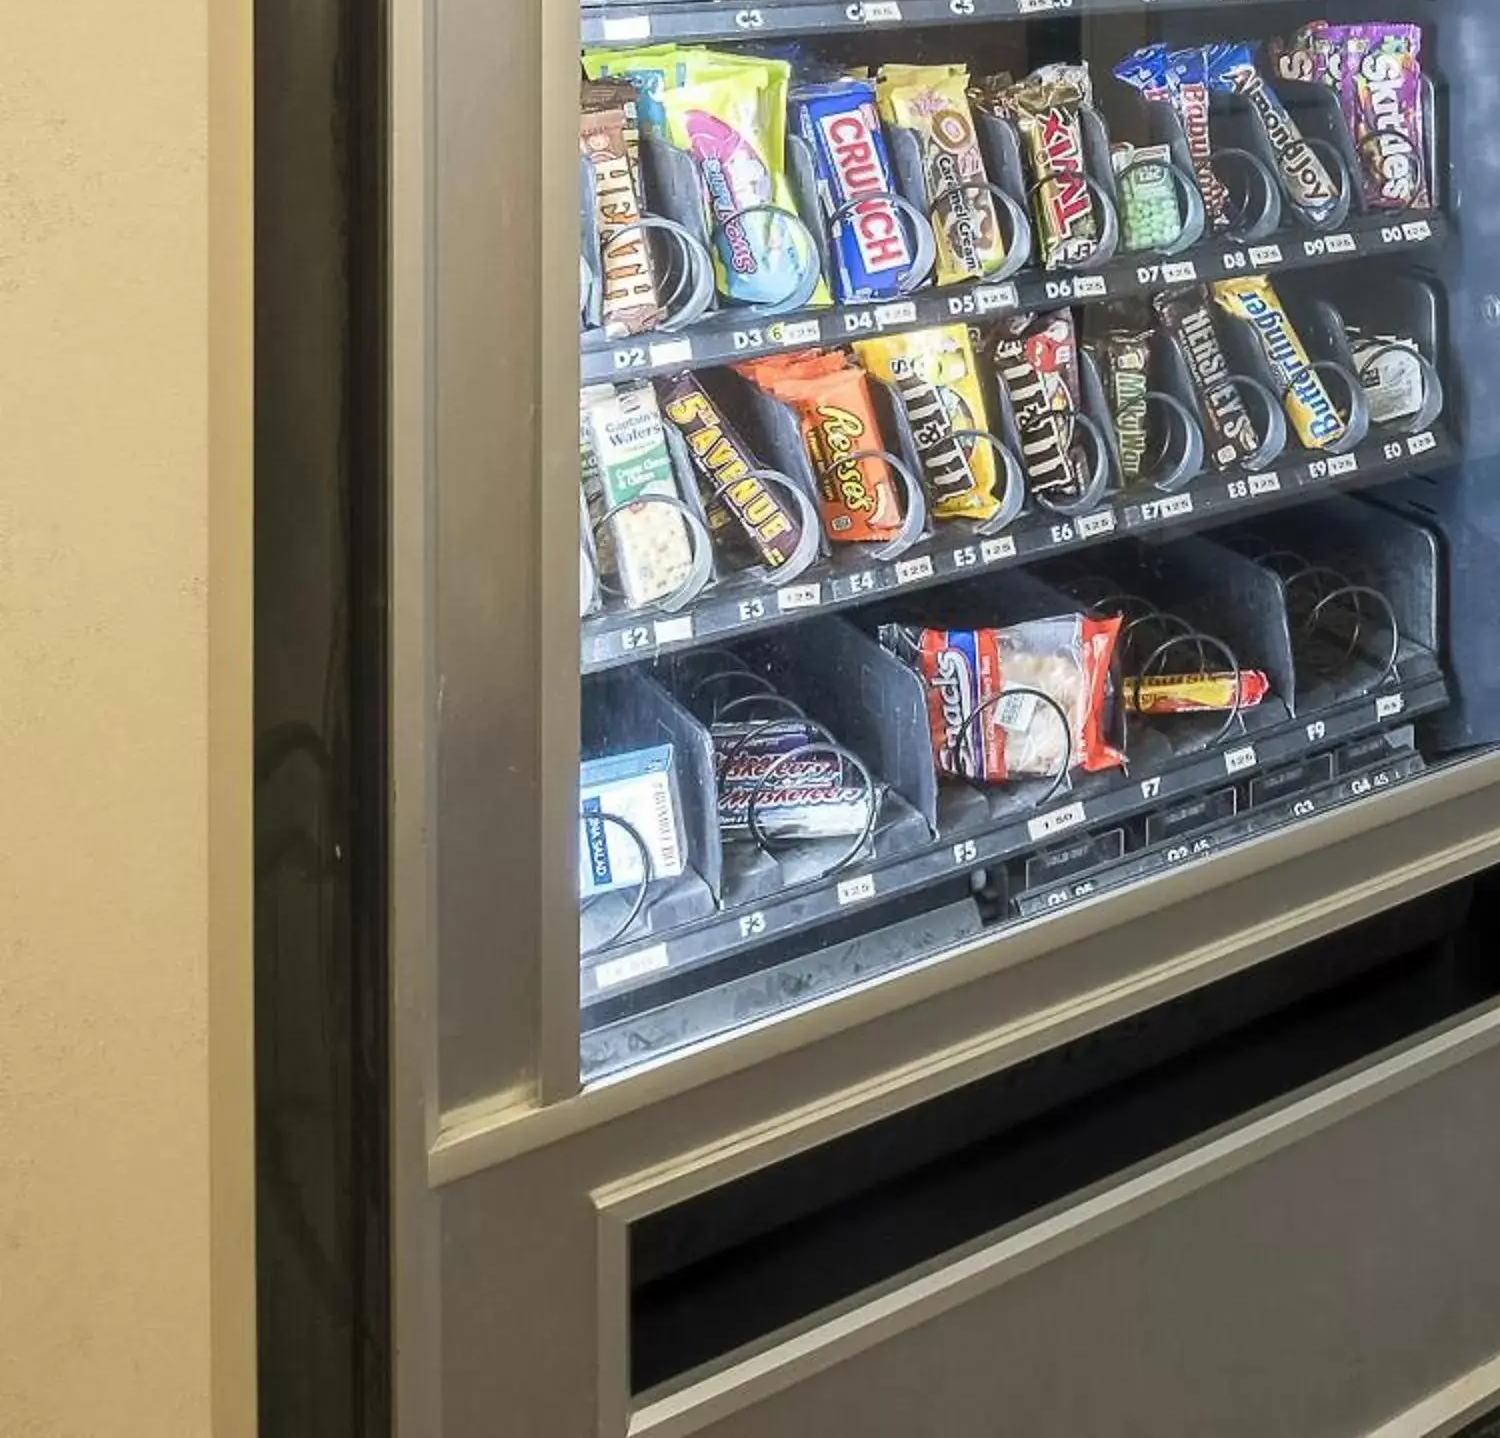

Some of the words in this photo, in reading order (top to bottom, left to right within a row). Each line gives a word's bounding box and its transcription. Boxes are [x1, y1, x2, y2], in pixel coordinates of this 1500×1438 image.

[735, 9, 764, 28] C3
[1361, 52, 1412, 201] Skitles
[1038, 106, 1094, 241] TWIX
[828, 116, 904, 266] CRUNCH
[938, 155, 968, 221] Carmel
[1381, 227, 1402, 244] D0
[1303, 240, 1325, 257] D9
[1223, 252, 1246, 270] D8
[1136, 267, 1160, 285] D7
[1045, 280, 1072, 297] D6
[949, 296, 976, 315] D5
[844, 313, 872, 331] D4
[733, 328, 764, 348] D3
[613, 348, 647, 369] D2
[1237, 290, 1343, 441] Butterfinger
[1180, 307, 1249, 438] HERSEY'S
[816, 405, 874, 512] Reese's
[1382, 442, 1402, 459] E0
[1308, 461, 1328, 479] E9
[685, 425, 795, 545] AVENUE
[1227, 482, 1249, 500] E8
[1140, 502, 1160, 521] E7
[1050, 524, 1074, 543] E6
[952, 549, 978, 567] E5
[848, 574, 875, 592] E4
[738, 601, 765, 620] E3
[621, 627, 649, 647] E2
[1306, 721, 1326, 742] F9
[1140, 777, 1162, 799] F7
[952, 840, 978, 864] F5
[738, 913, 767, 938] F3
